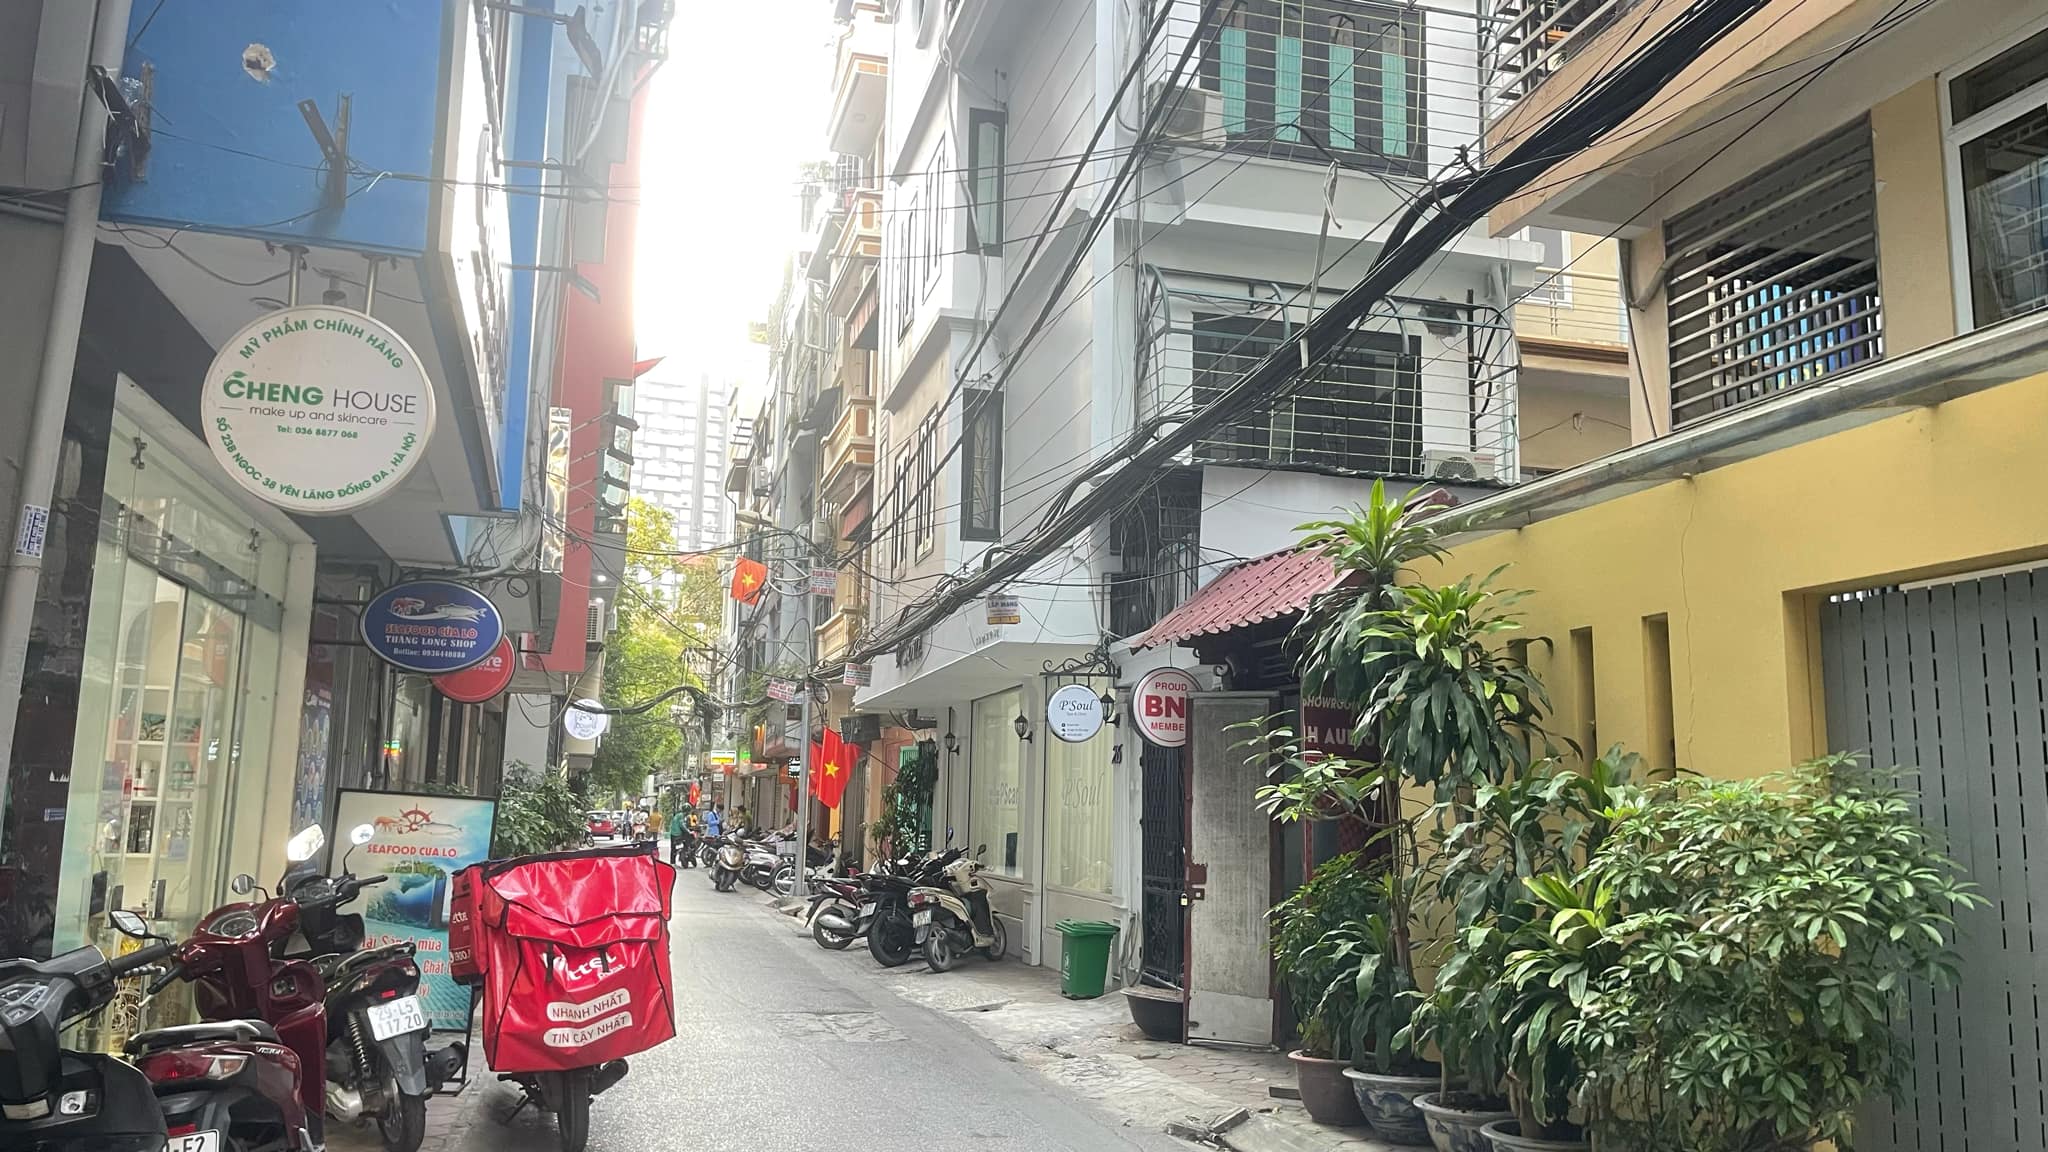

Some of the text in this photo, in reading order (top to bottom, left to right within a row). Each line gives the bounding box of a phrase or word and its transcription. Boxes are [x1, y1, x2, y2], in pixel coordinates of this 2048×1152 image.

[240, 336, 261, 359] MỸ
[313, 318, 365, 338] CHÍNH
[223, 377, 417, 414] CHENG HOUSE
[249, 405, 388, 426] make up and skincare
[277, 425, 358, 439] Tel: 036 8877 068
[216, 416, 232, 432] SỐ
[262, 477, 277, 489] 38
[280, 484, 300, 498] YÊN
[390, 451, 406, 467] HÀ
[401, 432, 417, 452] NỘI
[421, 637, 447, 647] LONG
[450, 638, 477, 649] SHOP
[1155, 681, 1187, 691] PROUD
[1060, 699, 1096, 712] P'Soul
[1145, 694, 1185, 718] BN
[1151, 721, 1185, 732] MEMBE
[367, 843, 417, 855] SEAFOOD
[552, 992, 624, 1020] NHANH NHẤT
[552, 1033, 569, 1044] TIN
[597, 1014, 627, 1035] NHẤT
